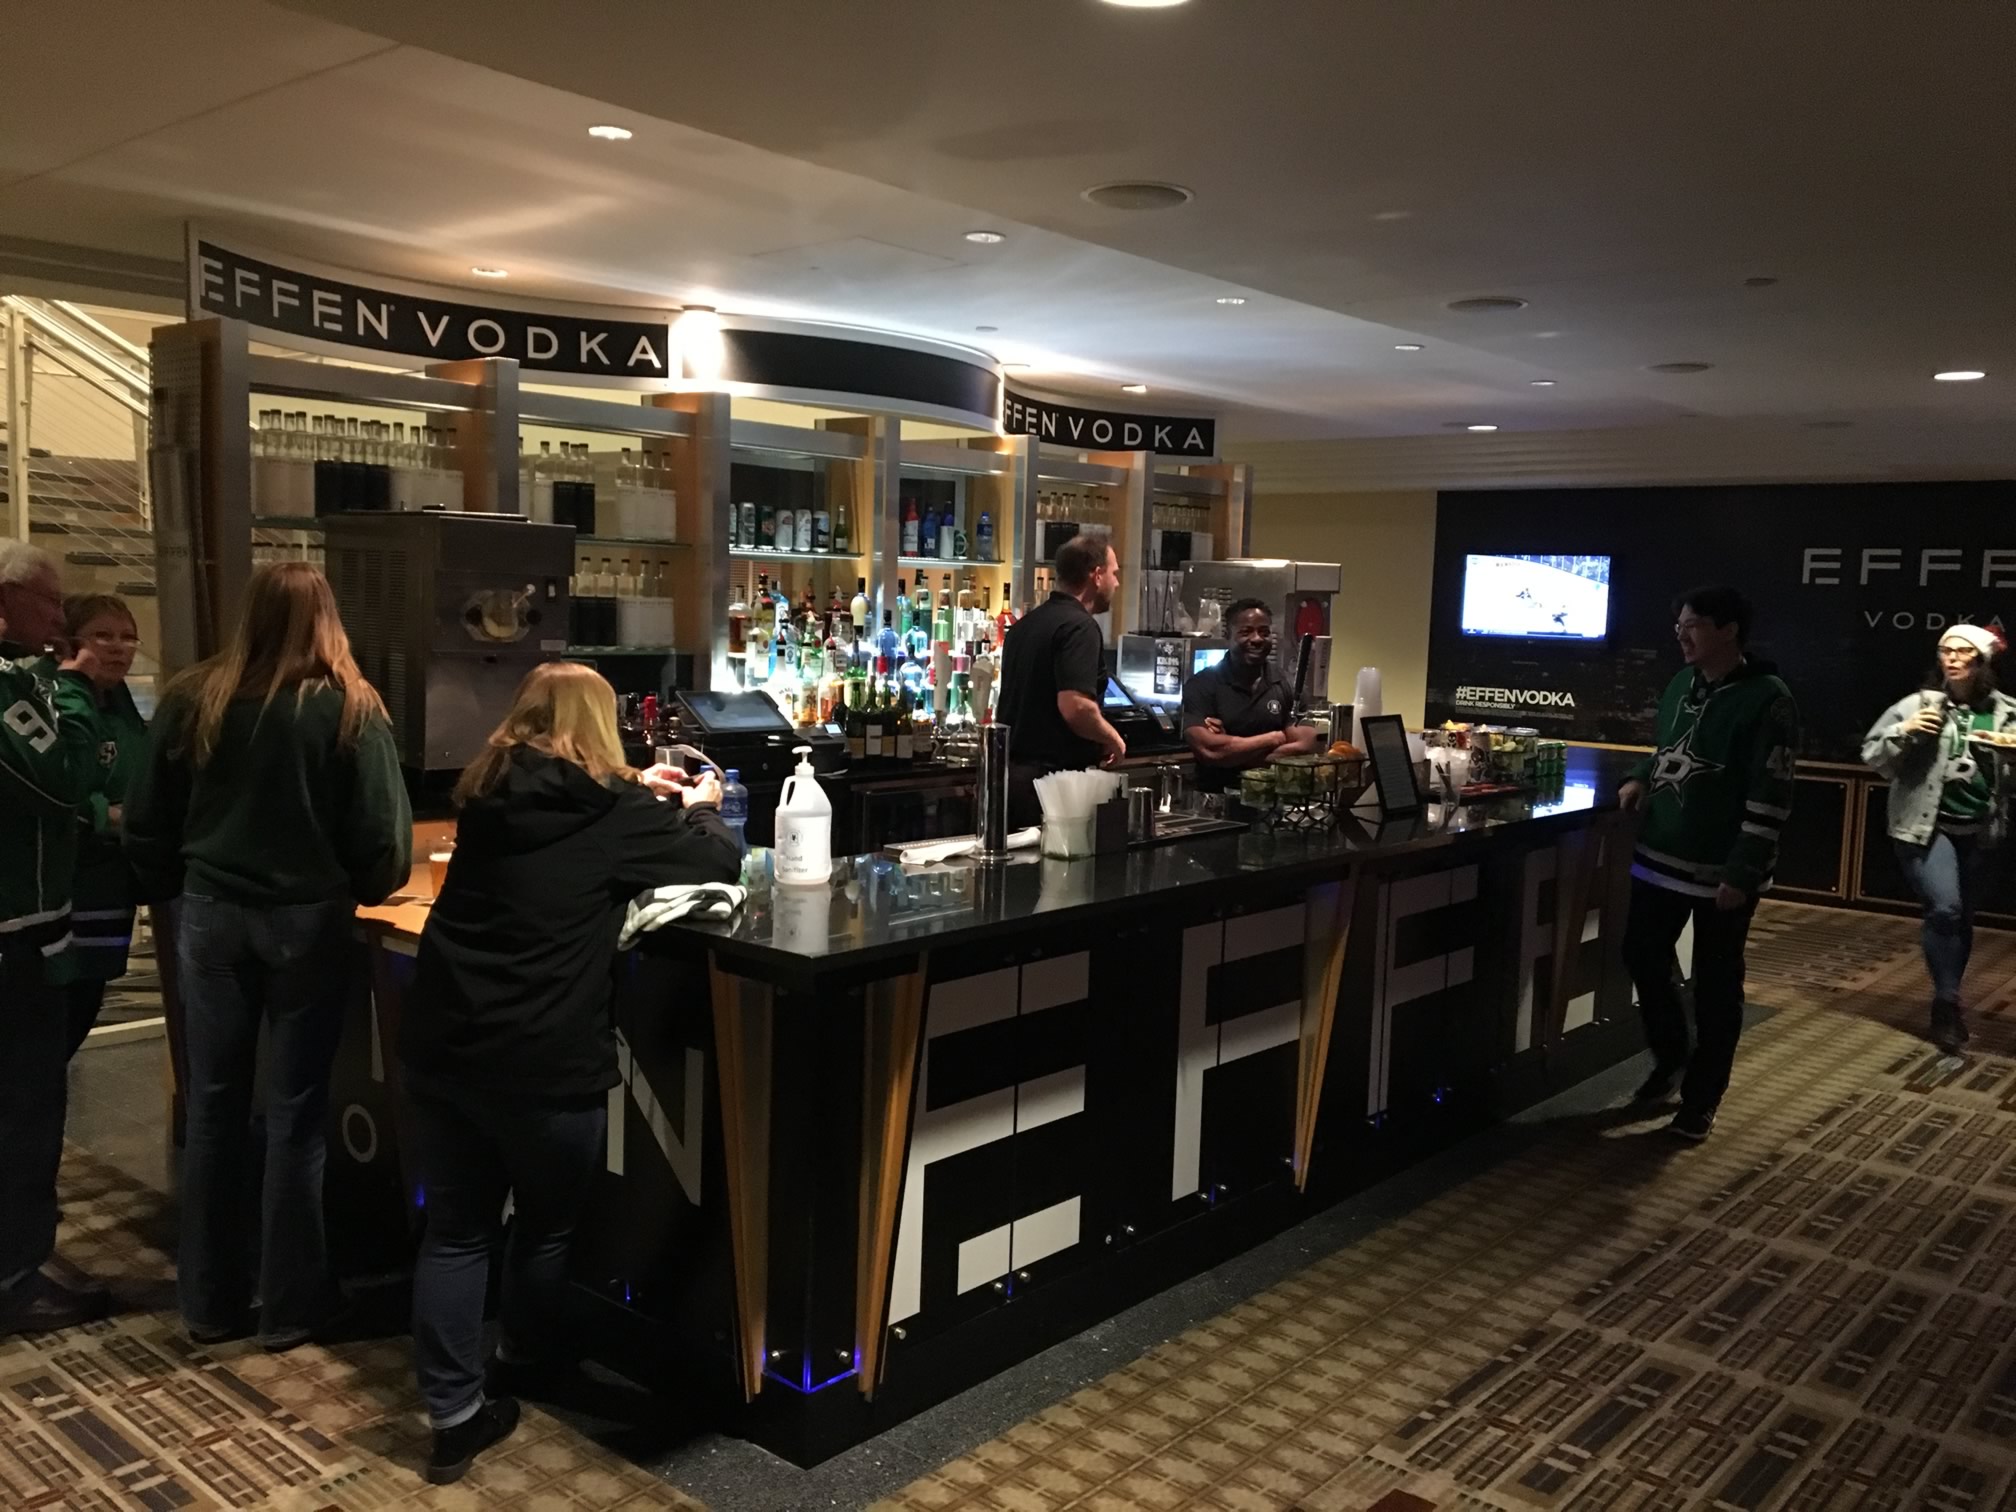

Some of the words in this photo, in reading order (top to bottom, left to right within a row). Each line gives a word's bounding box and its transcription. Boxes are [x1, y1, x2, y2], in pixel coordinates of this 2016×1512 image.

[199, 255, 389, 341] EFFEN
[416, 309, 663, 369] VODKA
[1004, 398, 1056, 438] FFEN
[1067, 415, 1205, 450] VODKA
[1455, 685, 1576, 707] #EFFENVODKA
[1475, 701, 1516, 710] RESPONSIBLY
[3, 699, 58, 754] 9
